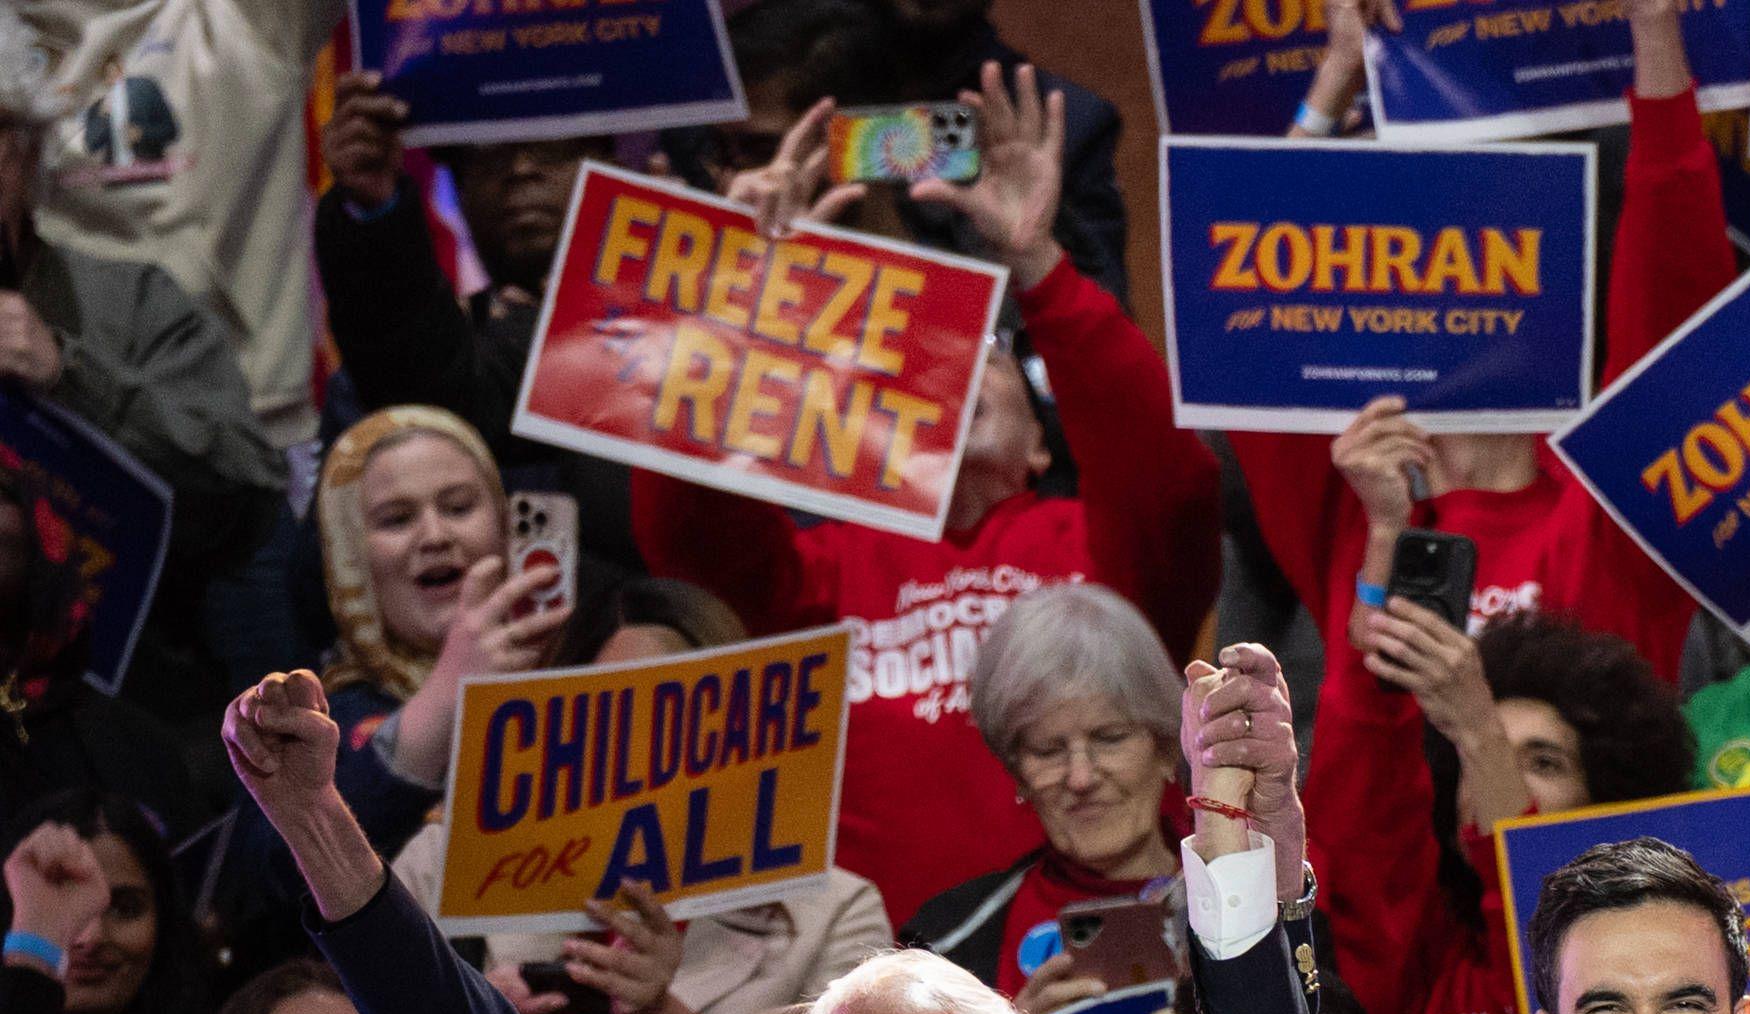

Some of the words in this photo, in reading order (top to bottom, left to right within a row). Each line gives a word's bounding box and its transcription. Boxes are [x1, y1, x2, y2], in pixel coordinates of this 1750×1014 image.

[1474, 9, 1551, 41] NEW
[592, 193, 927, 378] FREEZE
[1209, 222, 1544, 296] ZOHRAN
[1270, 306, 1345, 333] NEW
[1347, 307, 1439, 336] YORK
[1443, 309, 1526, 336] CITY
[652, 324, 943, 492] RENT
[477, 652, 829, 835] CHILDCARE
[474, 835, 591, 900] FOR
[594, 767, 803, 901] ALL
